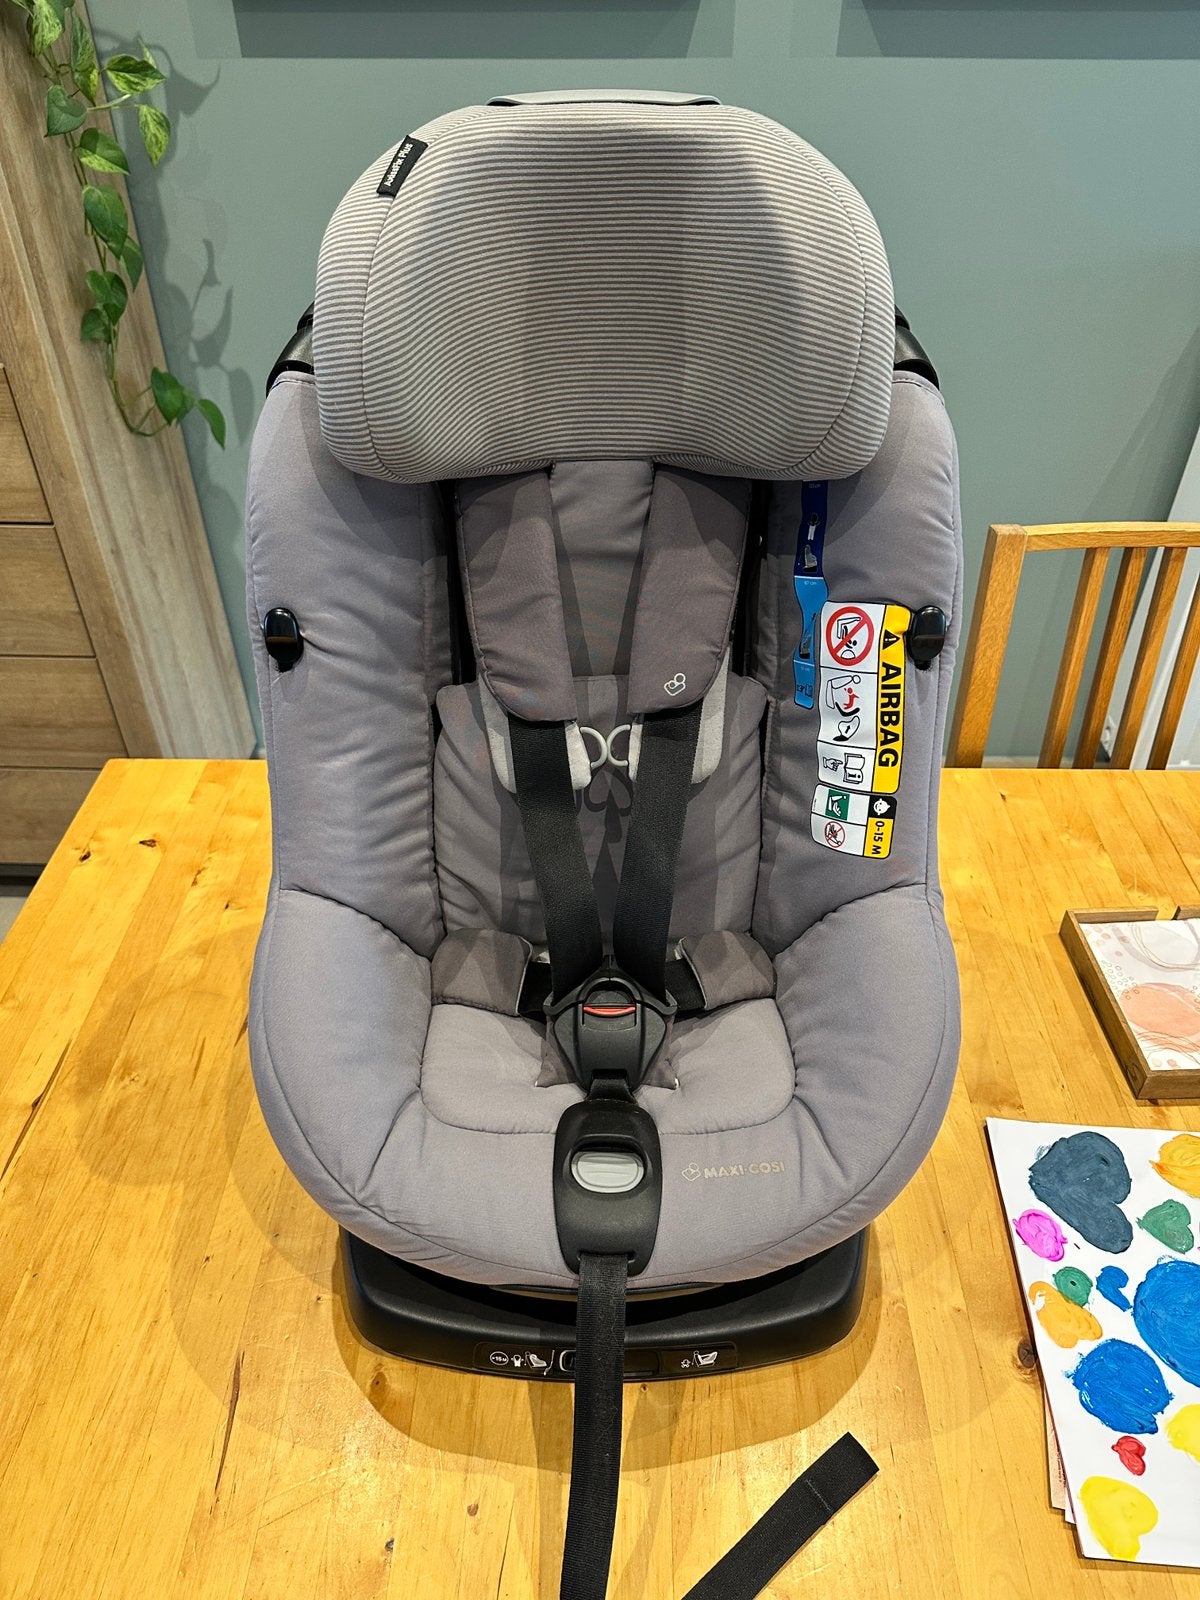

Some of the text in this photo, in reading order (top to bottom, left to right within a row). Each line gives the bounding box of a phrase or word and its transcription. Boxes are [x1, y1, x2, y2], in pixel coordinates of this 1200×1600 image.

[397, 143, 414, 158] Plus
[878, 661, 902, 768] AIRBAG
[871, 820, 885, 855] 0-15 M
